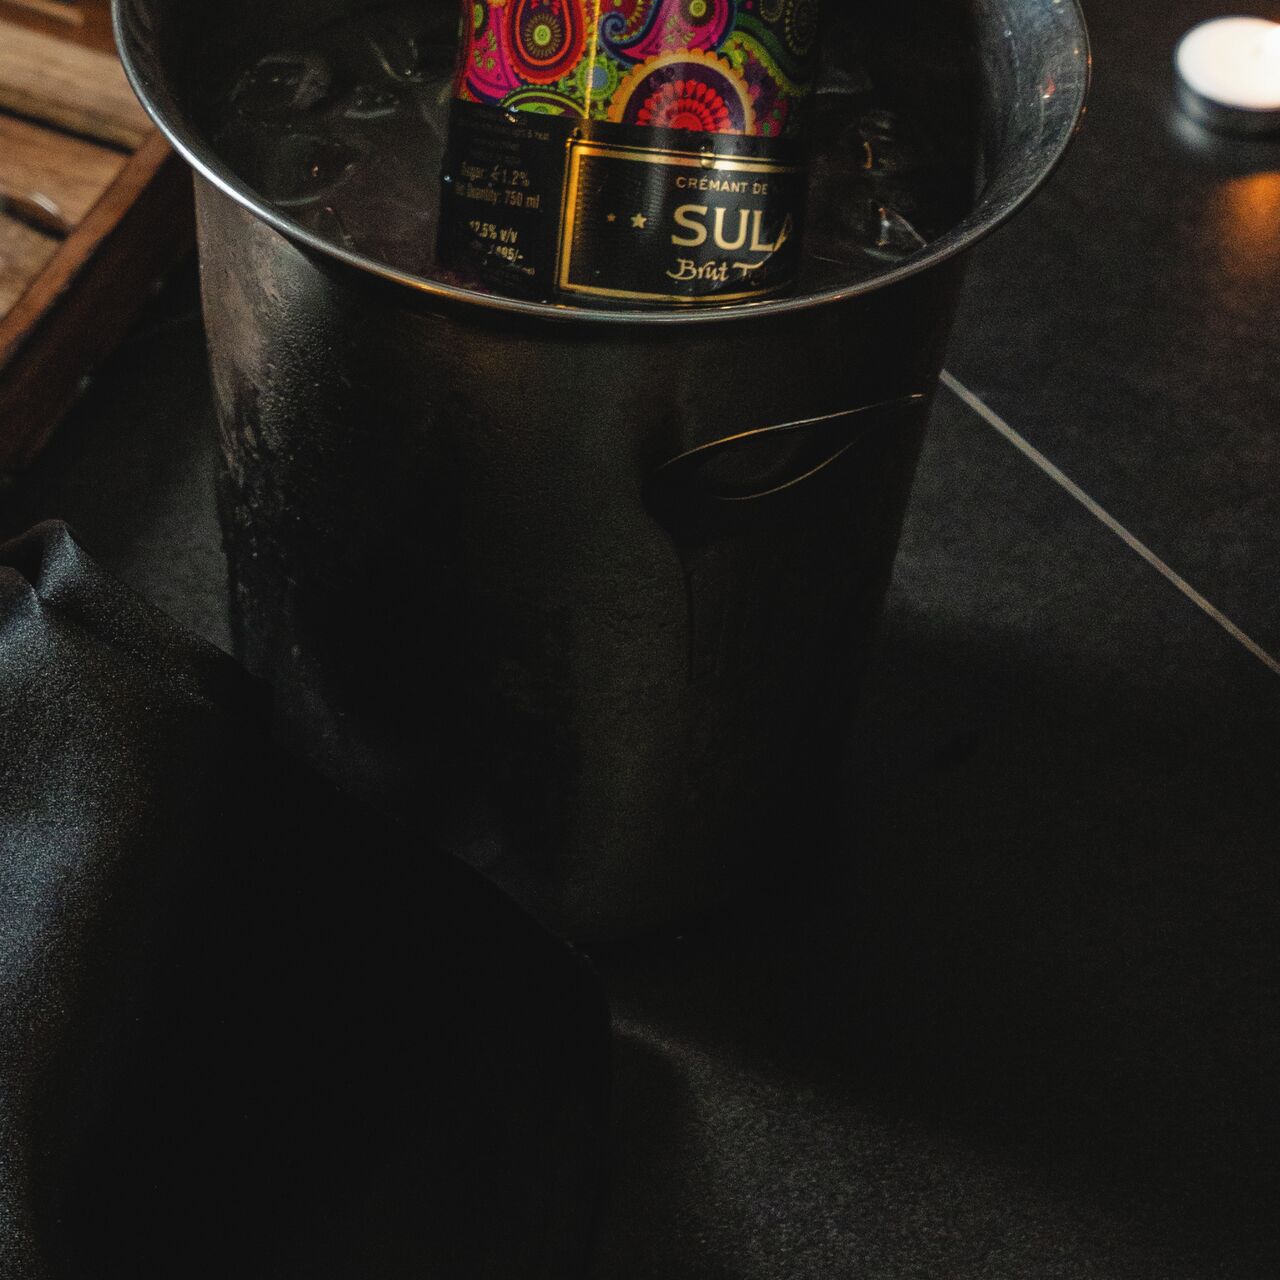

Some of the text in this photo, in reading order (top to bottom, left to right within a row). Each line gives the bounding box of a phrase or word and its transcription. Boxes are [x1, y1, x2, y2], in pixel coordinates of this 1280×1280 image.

[675, 175, 768, 196] CRÉMANT DE
[504, 189, 524, 207] 750
[526, 194, 540, 209] ml
[665, 257, 730, 282] Brut
